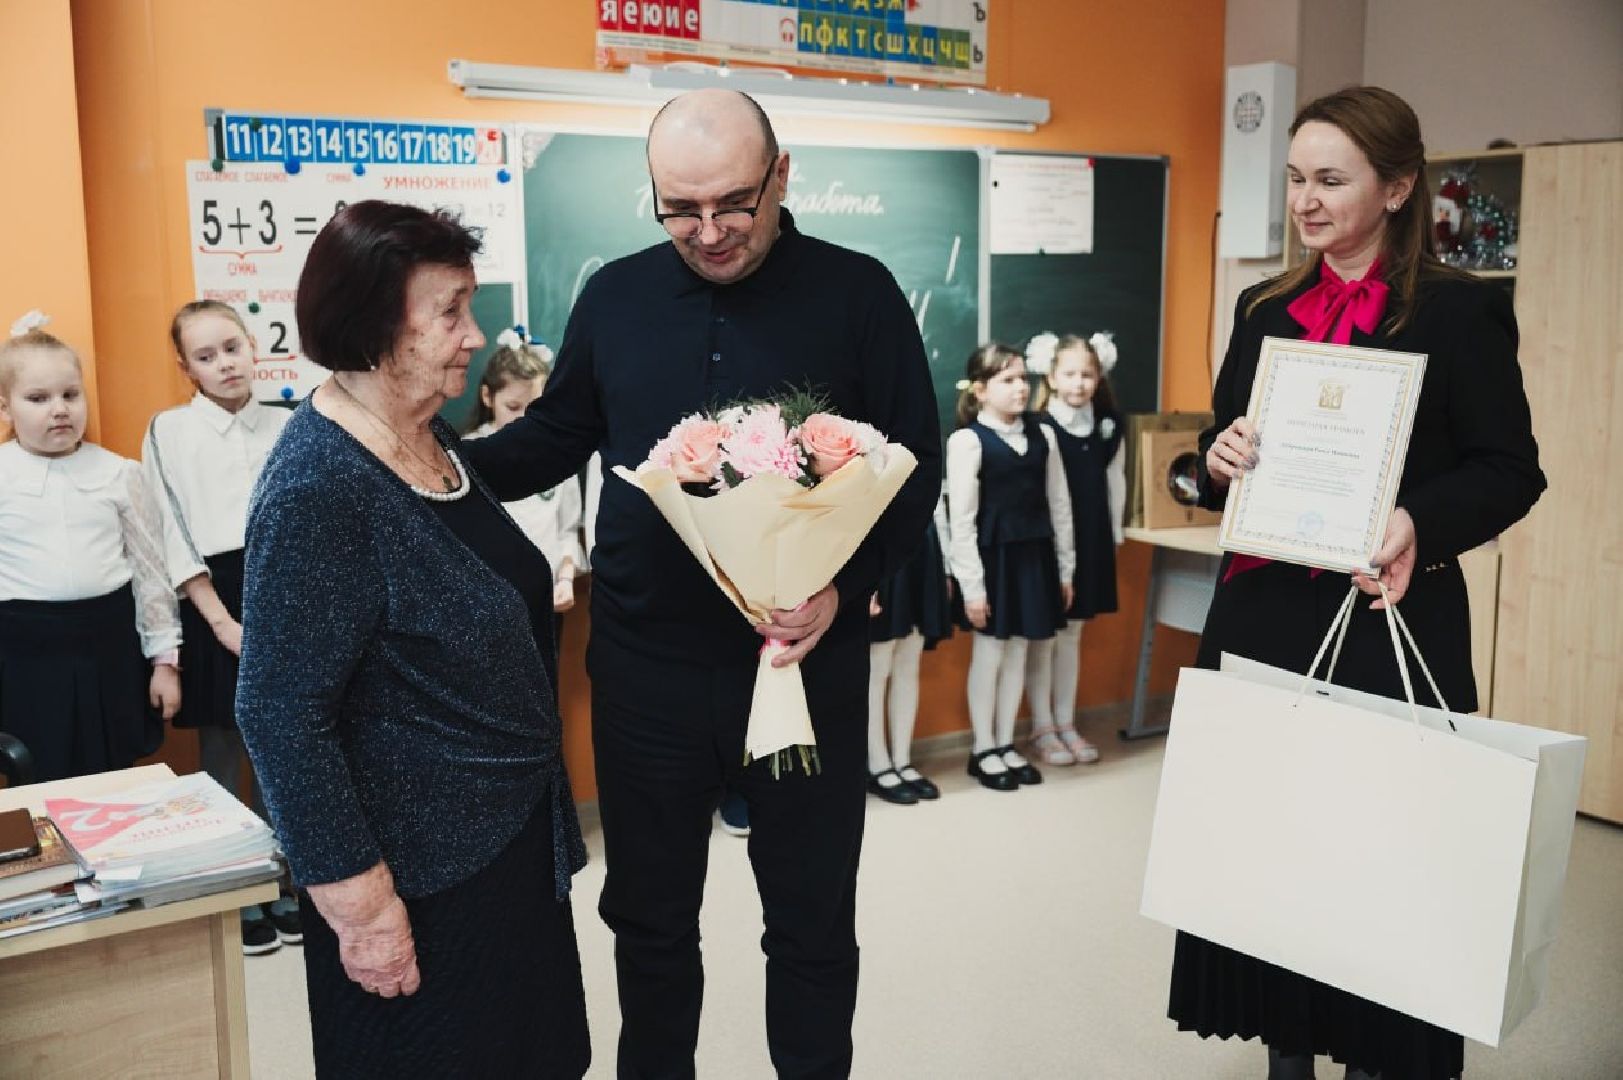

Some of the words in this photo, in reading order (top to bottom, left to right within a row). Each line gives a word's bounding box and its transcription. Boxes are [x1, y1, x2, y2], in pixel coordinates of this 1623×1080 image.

[227, 123, 252, 155] 11
[258, 124, 283, 156] 12
[287, 126, 312, 157] 13
[317, 127, 342, 158] 14
[345, 128, 370, 159] 15
[373, 129, 398, 160] 16
[401, 131, 424, 162] 17
[427, 132, 451, 162] 18
[453, 133, 476, 163] 19
[383, 175, 492, 190] УМНОЖЕНИЕ
[269, 322, 290, 354] 2
